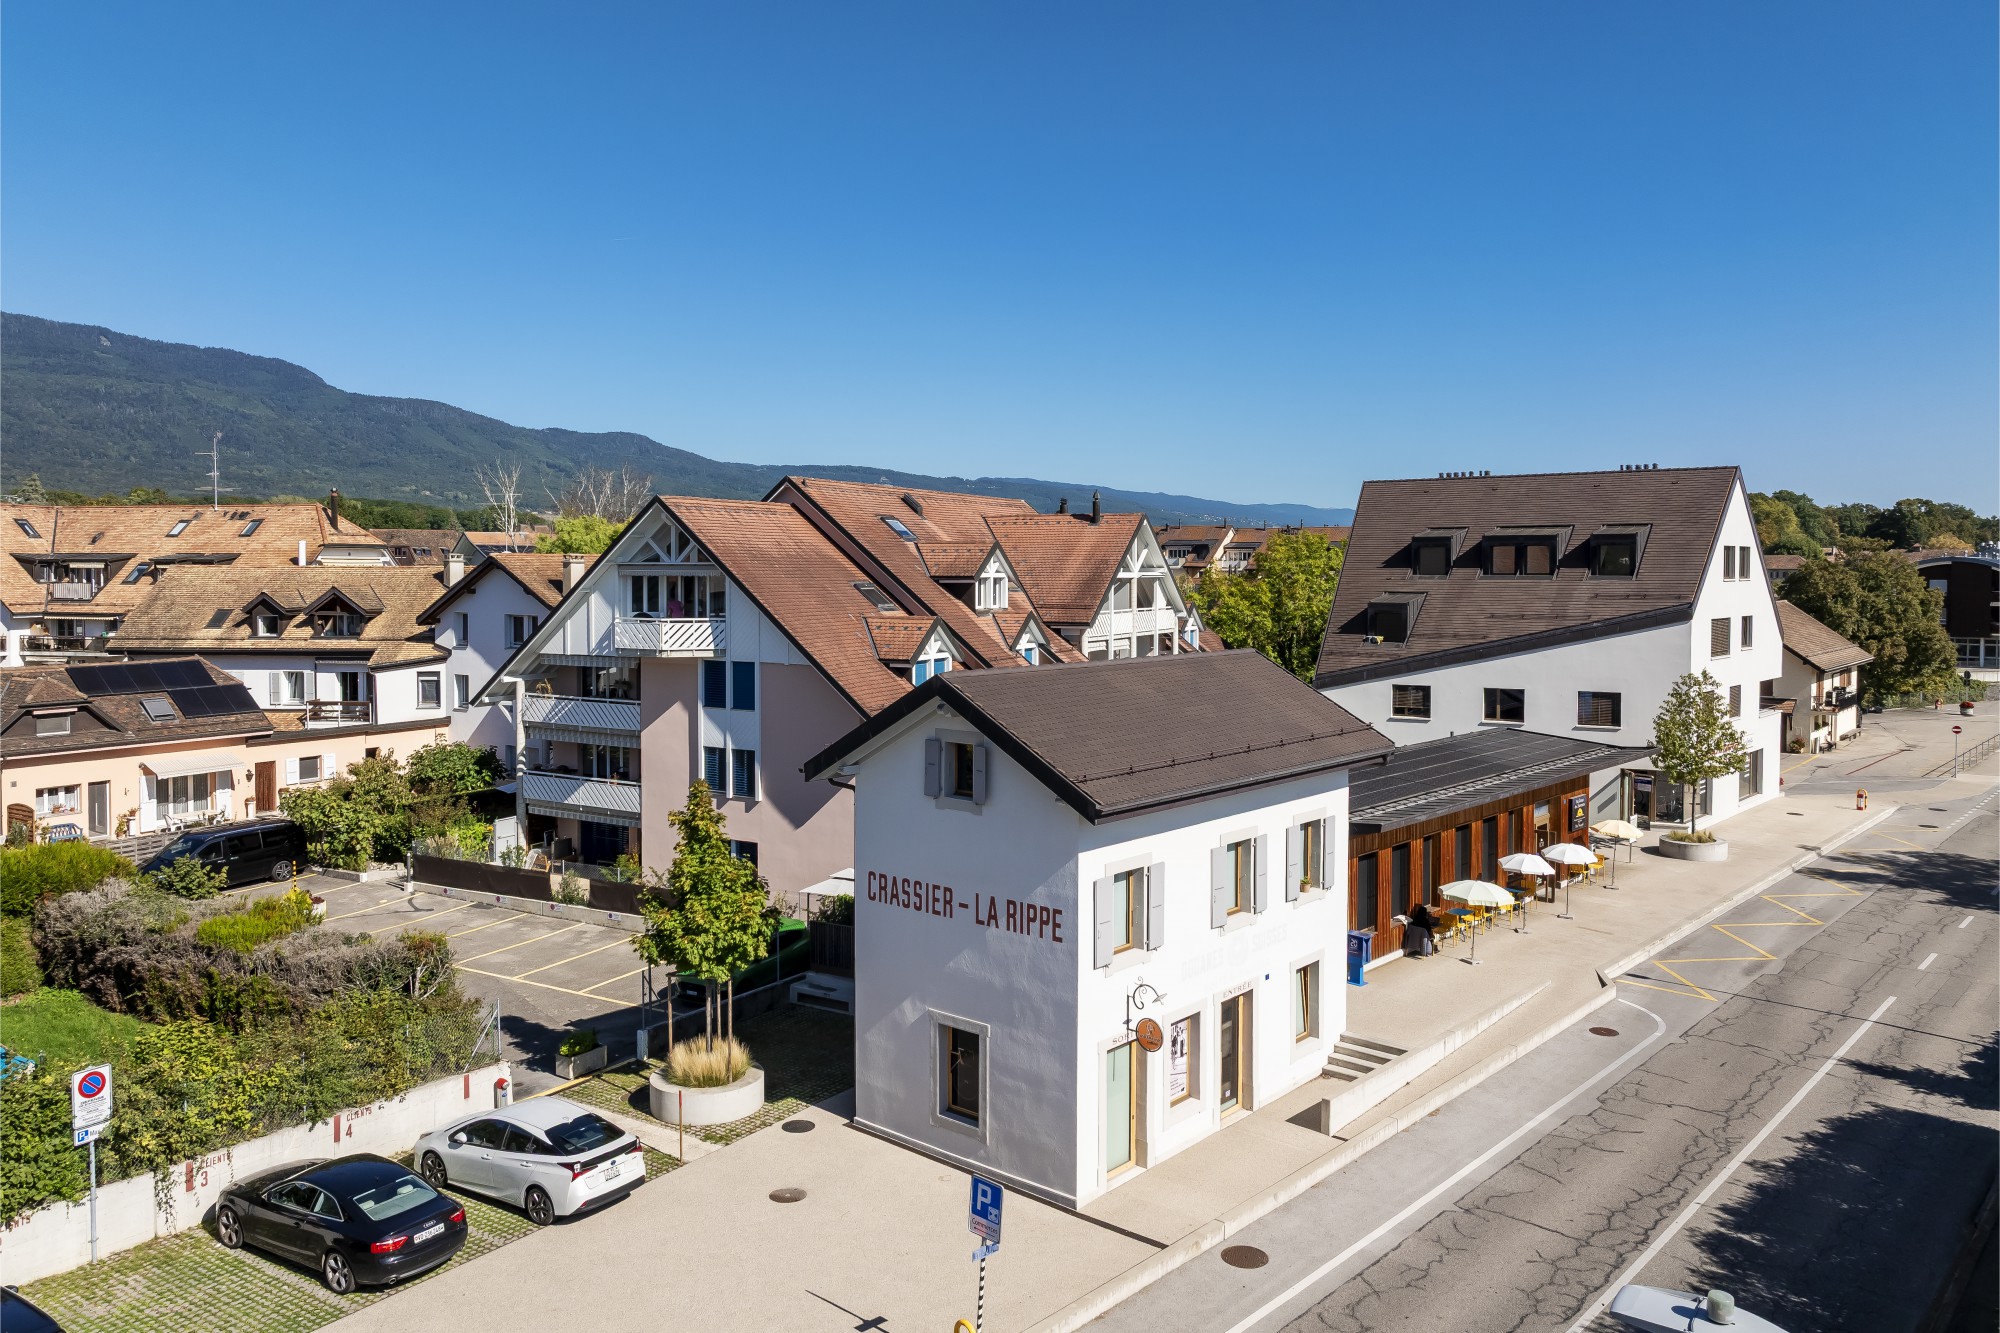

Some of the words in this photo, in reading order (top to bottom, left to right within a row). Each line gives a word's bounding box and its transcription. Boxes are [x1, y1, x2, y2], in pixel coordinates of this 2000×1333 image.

[867, 870, 953, 919] CRASSIER
[975, 892, 999, 929] LA
[1006, 899, 1063, 943] RIPPE
[1223, 980, 1253, 998] ENTRÉE
[1112, 1031, 1135, 1046] SORT
[346, 1106, 372, 1122] CLIENTS
[345, 1123, 353, 1139] 4
[200, 1170, 209, 1188] 3
[976, 1183, 992, 1211] P
